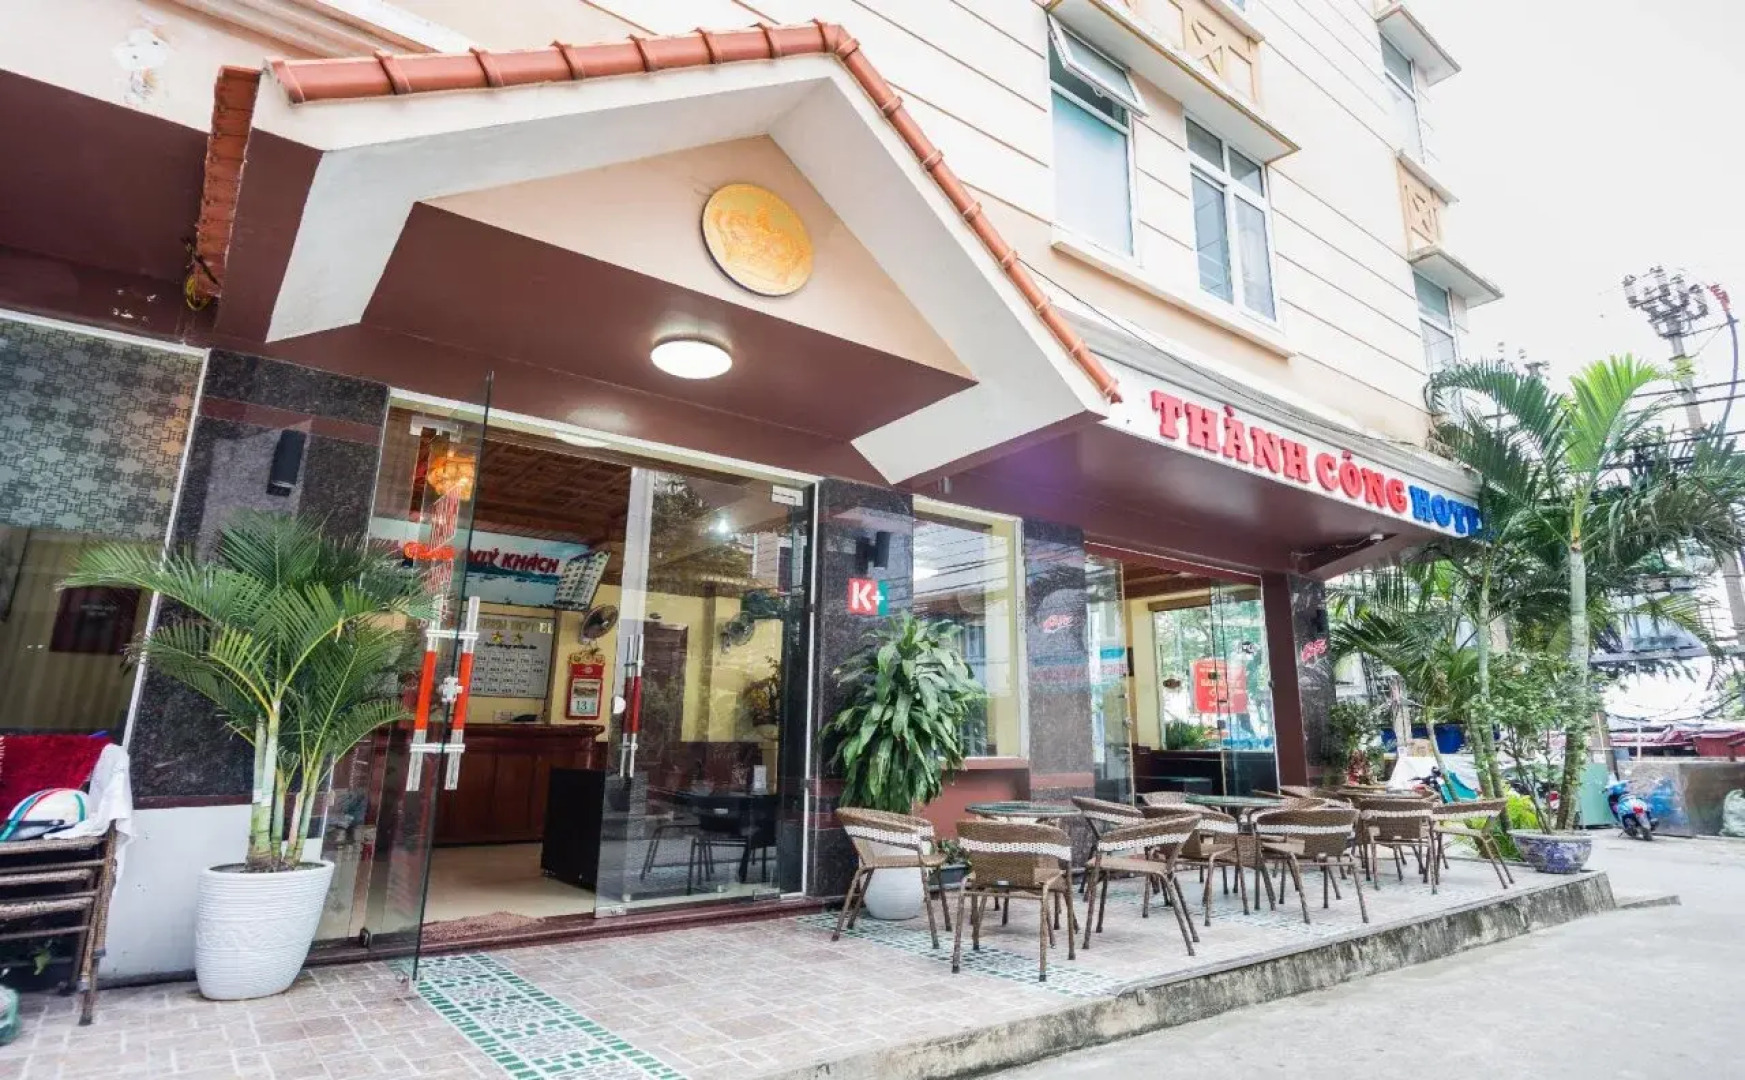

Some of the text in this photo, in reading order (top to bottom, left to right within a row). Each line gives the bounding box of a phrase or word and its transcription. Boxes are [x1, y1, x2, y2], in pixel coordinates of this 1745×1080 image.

[1150, 389, 1494, 541] THÀNH CÔNG HOTE
[501, 553, 560, 573] KHÁCH
[851, 581, 885, 611] K+
